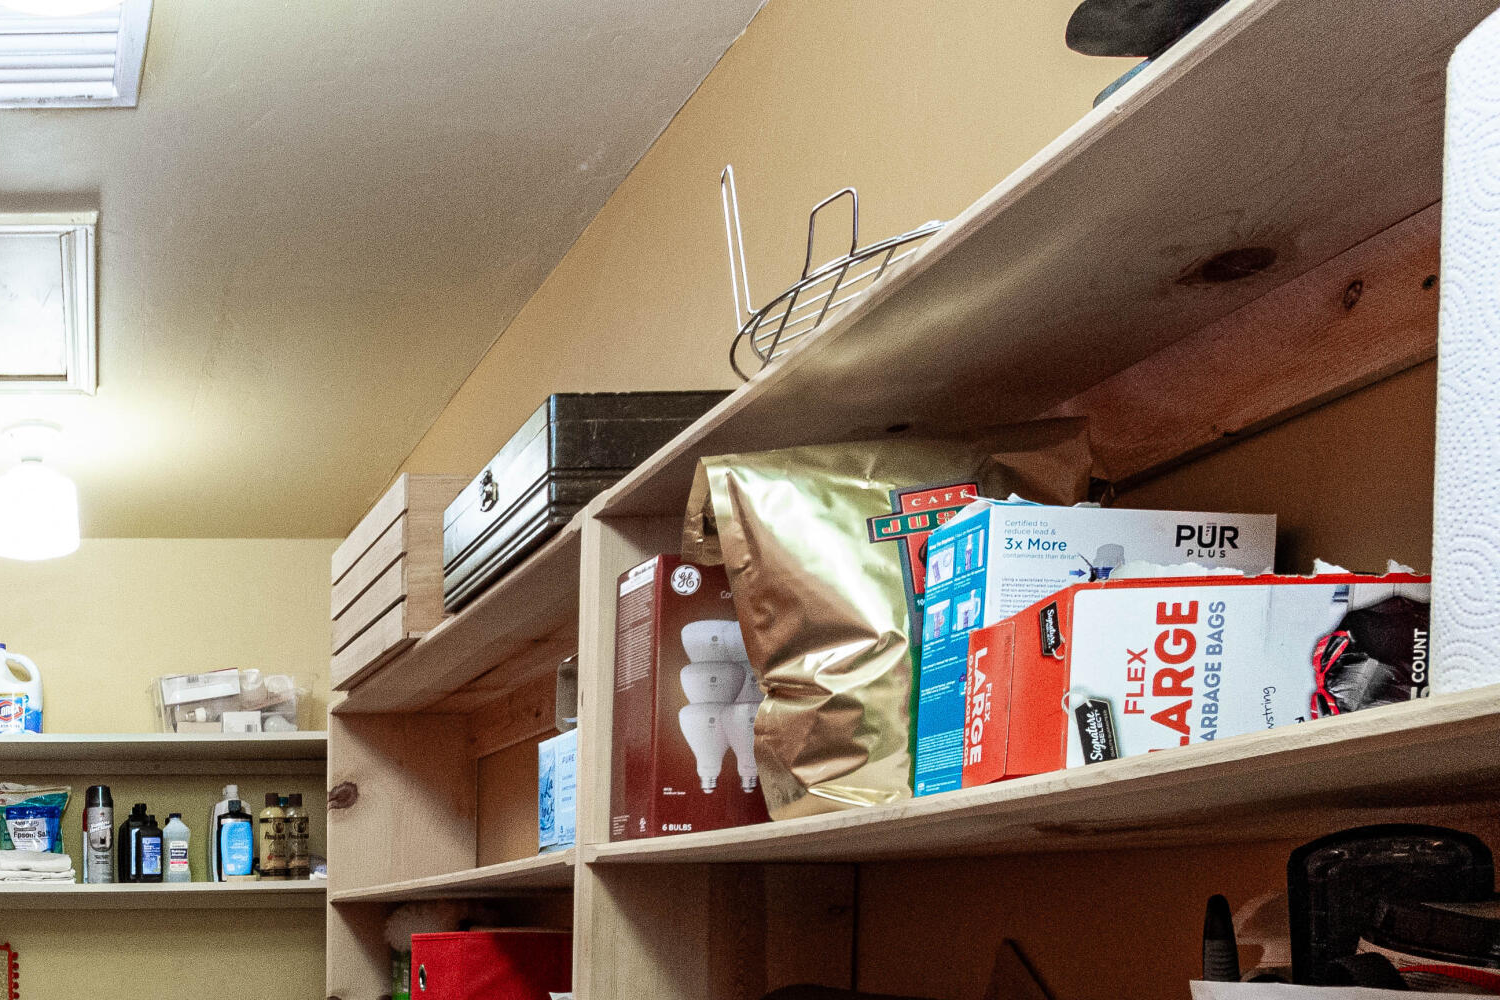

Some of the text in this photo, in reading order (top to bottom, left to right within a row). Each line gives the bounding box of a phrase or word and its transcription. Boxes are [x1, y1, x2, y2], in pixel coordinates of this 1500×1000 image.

[882, 511, 956, 534] JUS
[1004, 519, 1048, 527] Certified to
[1004, 537, 1067, 551] 3x More
[1187, 549, 1226, 559] PLUS
[1199, 600, 1226, 742] ARBAGE BAGS
[1411, 628, 1428, 683] COUNT
[964, 654, 974, 724] GARBAGE
[984, 682, 993, 723] FLEX
[1123, 648, 1148, 714] FLEX
[969, 647, 988, 766] LARGE
[1261, 686, 1277, 729] wstring
[1085, 711, 1107, 761] Signature
[662, 823, 693, 832] 6 BULBS
